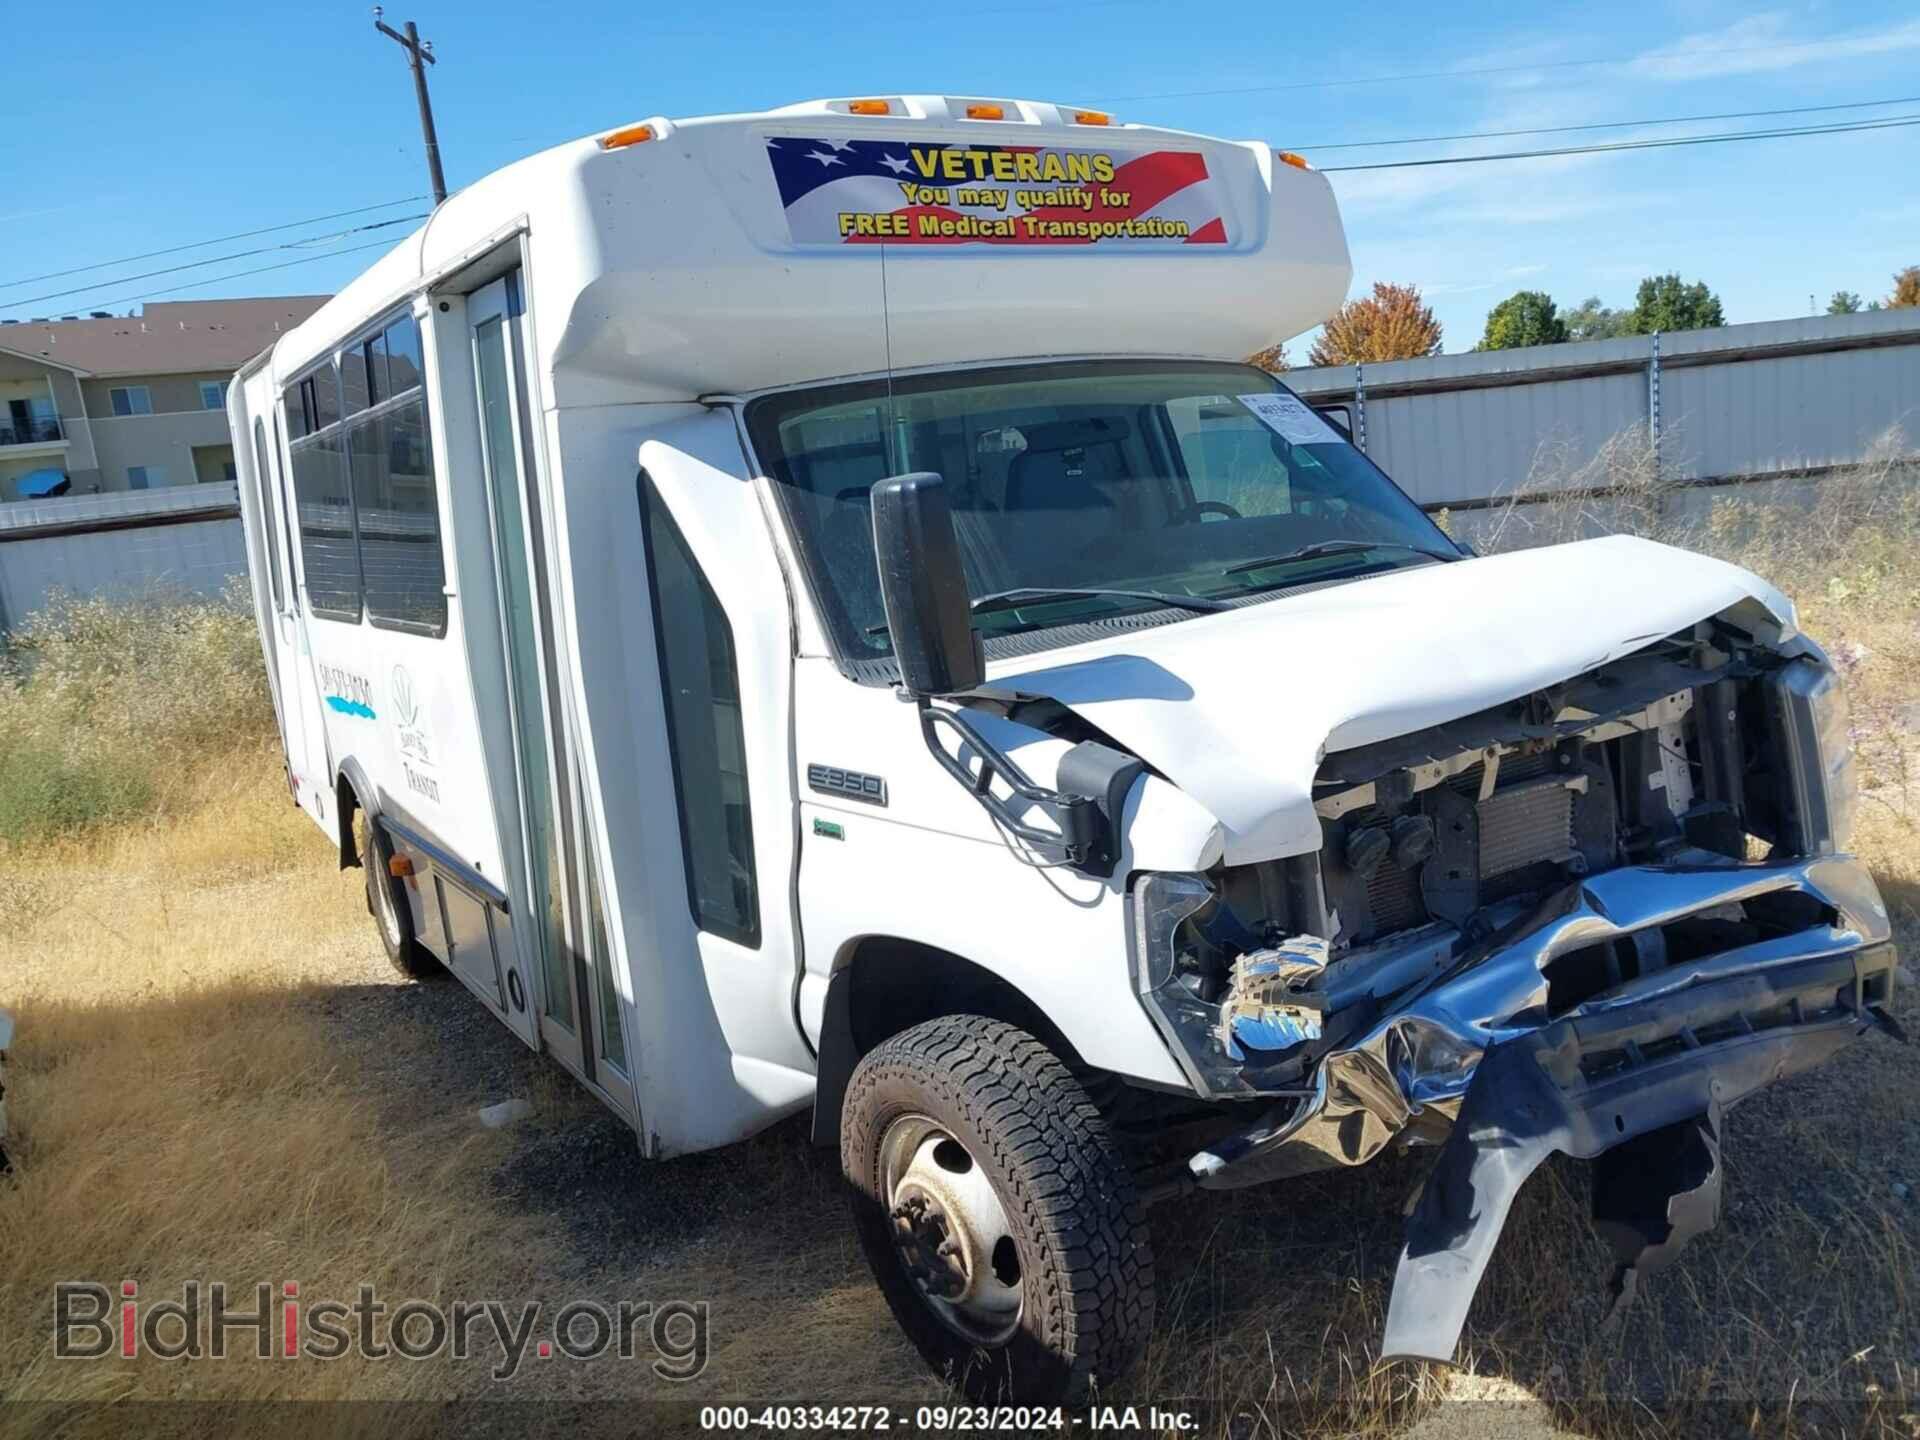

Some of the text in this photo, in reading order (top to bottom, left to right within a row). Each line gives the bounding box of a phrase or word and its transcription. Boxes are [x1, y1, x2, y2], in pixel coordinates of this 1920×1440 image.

[911, 148, 1115, 184] VETERANS
[900, 182, 1131, 212] You may qualify for
[839, 212, 1189, 242] FREE Medical Transportation
